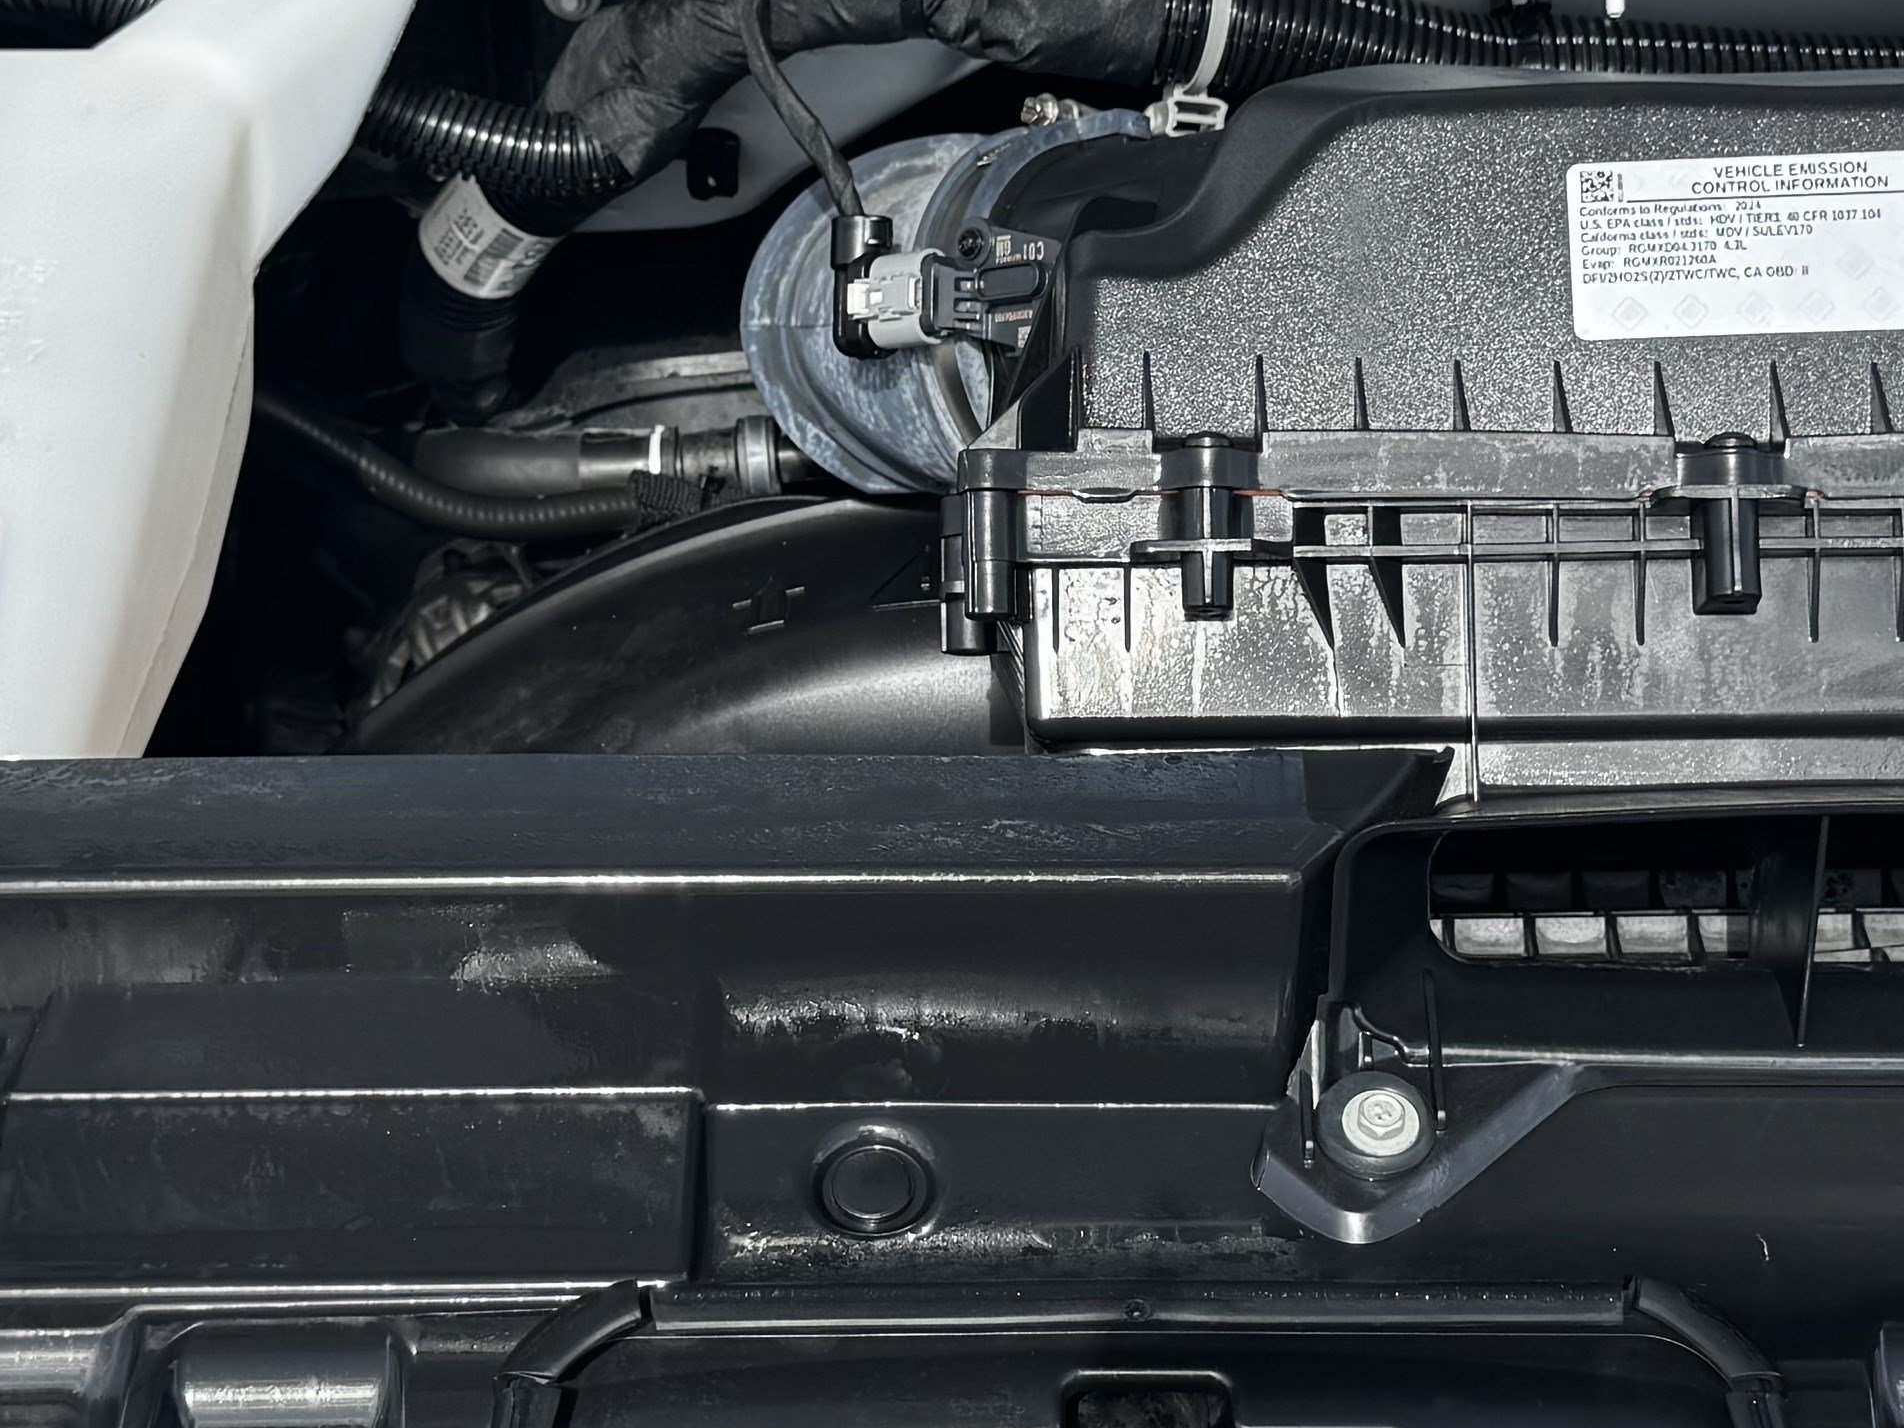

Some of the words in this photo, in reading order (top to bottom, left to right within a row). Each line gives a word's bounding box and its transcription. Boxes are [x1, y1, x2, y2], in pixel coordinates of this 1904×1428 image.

[1713, 164, 1783, 178] VEHICLE
[1789, 160, 1868, 176] EMISSION
[1692, 180, 1770, 194] CONTROL
[1776, 176, 1889, 190] INFORMATION
[1580, 207, 1636, 216] Conforms
[1639, 205, 1650, 214] to
[1607, 218, 1630, 229] EPA
[1634, 217, 1664, 228] class
[1803, 210, 1827, 221] CFR
[1581, 232, 1636, 243] California
[1640, 230, 1669, 240] class
[1581, 245, 1621, 257] Group:
[1583, 258, 1614, 270] Evap:
[1744, 267, 1762, 277] CA
